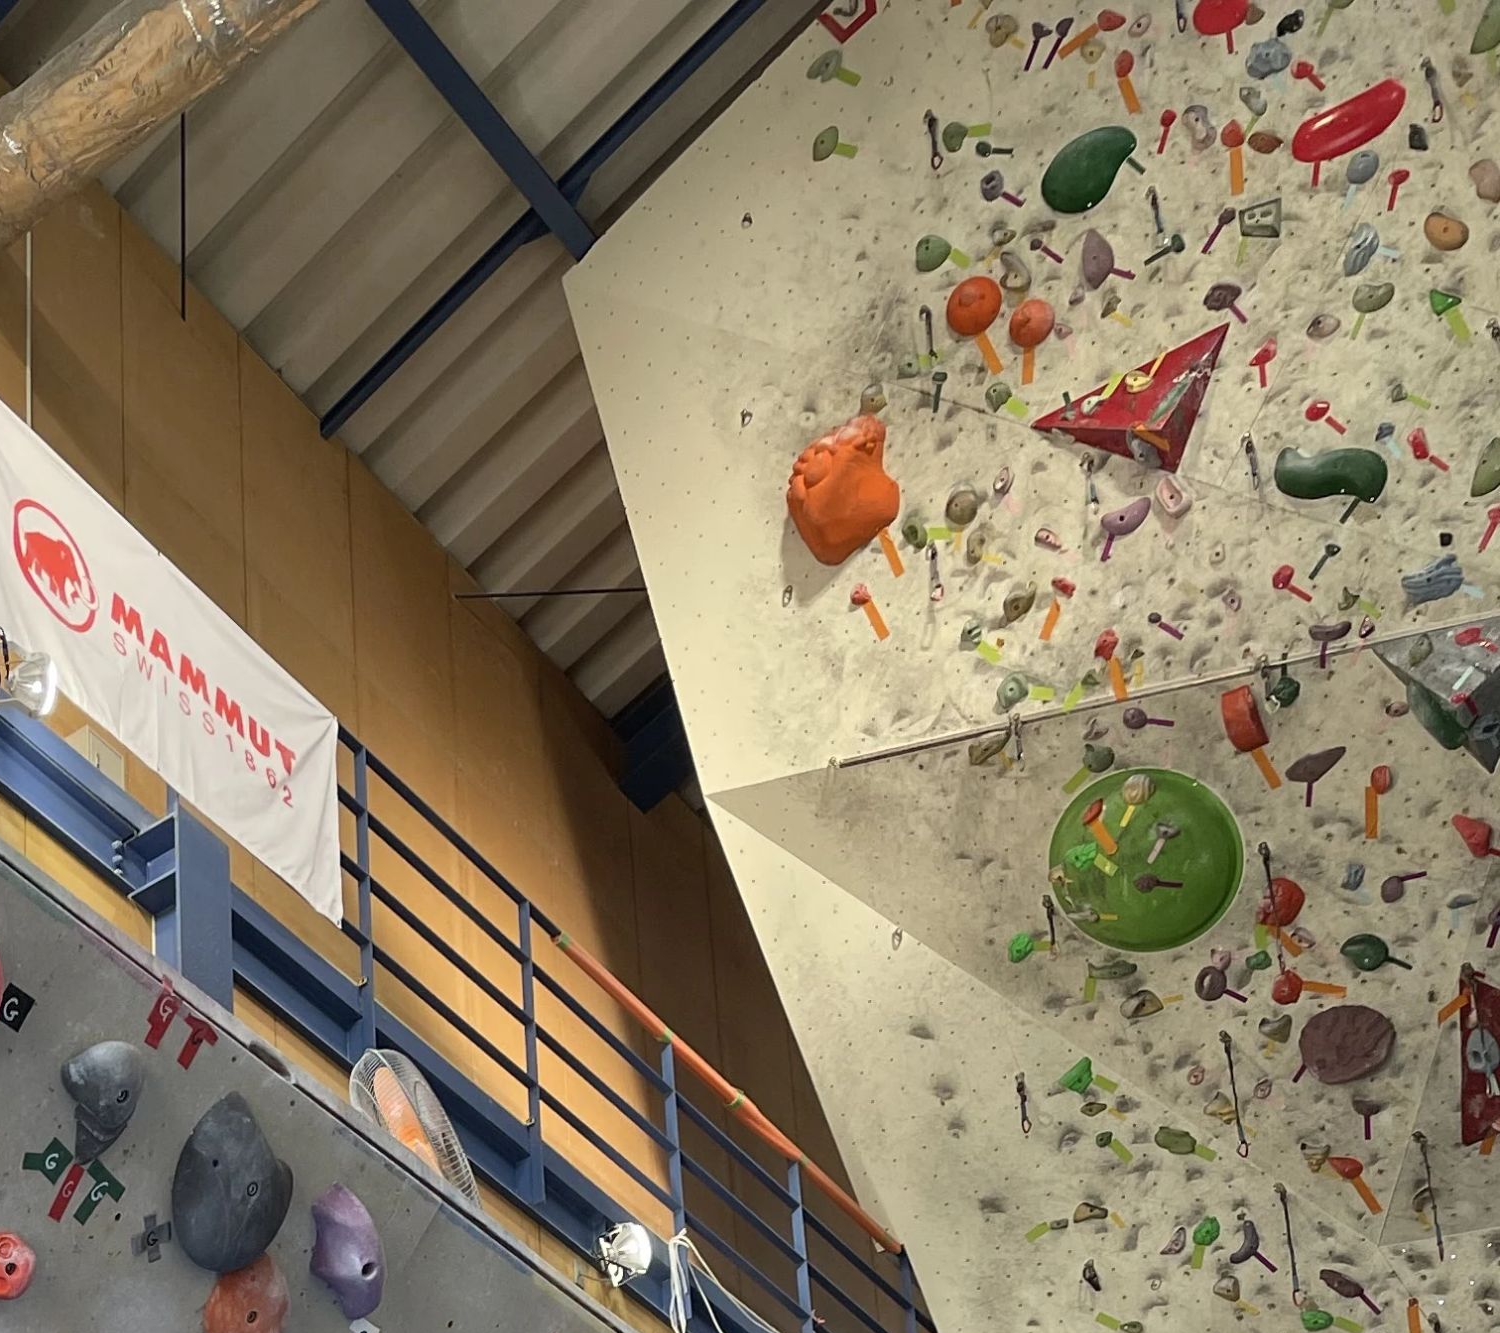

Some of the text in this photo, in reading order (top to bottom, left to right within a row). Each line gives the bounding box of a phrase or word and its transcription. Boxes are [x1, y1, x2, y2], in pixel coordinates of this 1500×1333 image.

[110, 592, 296, 776] MAMMUT
[113, 632, 294, 808] SWISS 1862
[2, 996, 19, 1022] G
[160, 995, 173, 1023] G
[44, 1154, 60, 1170] G
[62, 1180, 74, 1198] G
[91, 1181, 109, 1202] G
[146, 1230, 158, 1247] G
